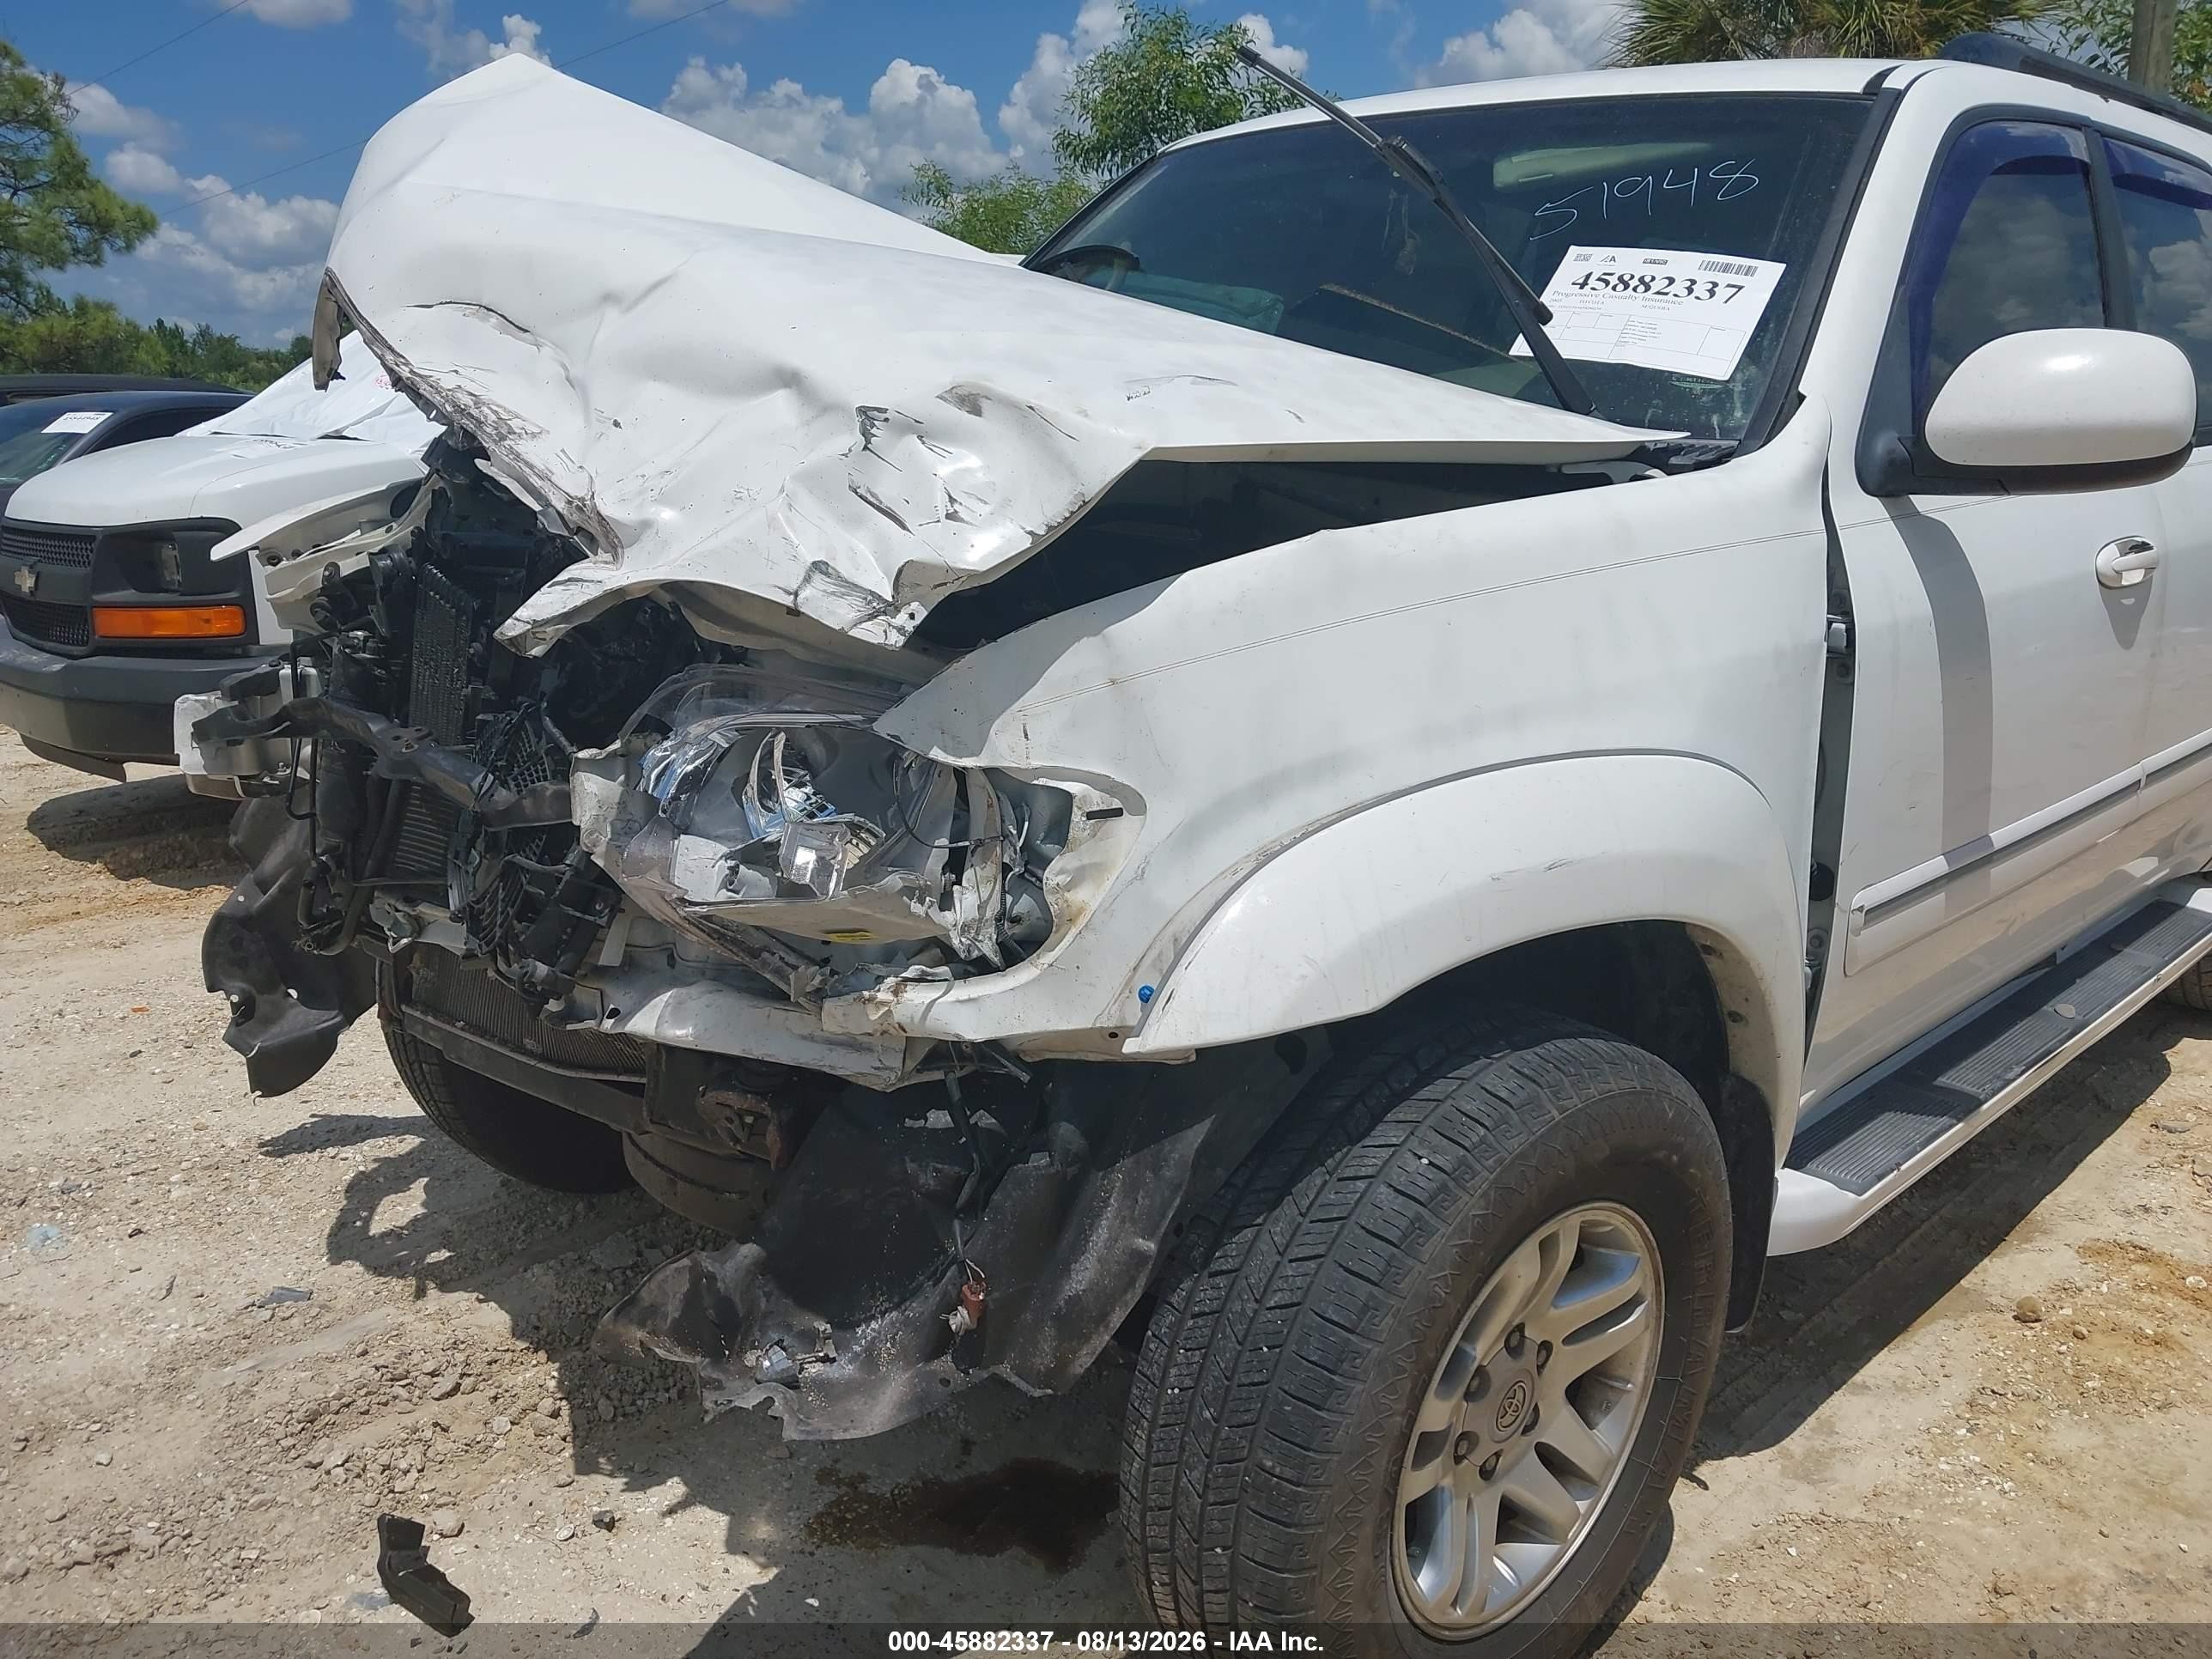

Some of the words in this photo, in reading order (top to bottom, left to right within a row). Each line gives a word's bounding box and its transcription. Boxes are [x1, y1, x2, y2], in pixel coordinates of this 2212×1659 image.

[1528, 158, 1759, 241] 51948
[1552, 290, 1601, 299] Progressive
[1602, 293, 1639, 301] Casualty
[1641, 295, 1684, 306] Insurance
[1571, 270, 1746, 305] 45882337
